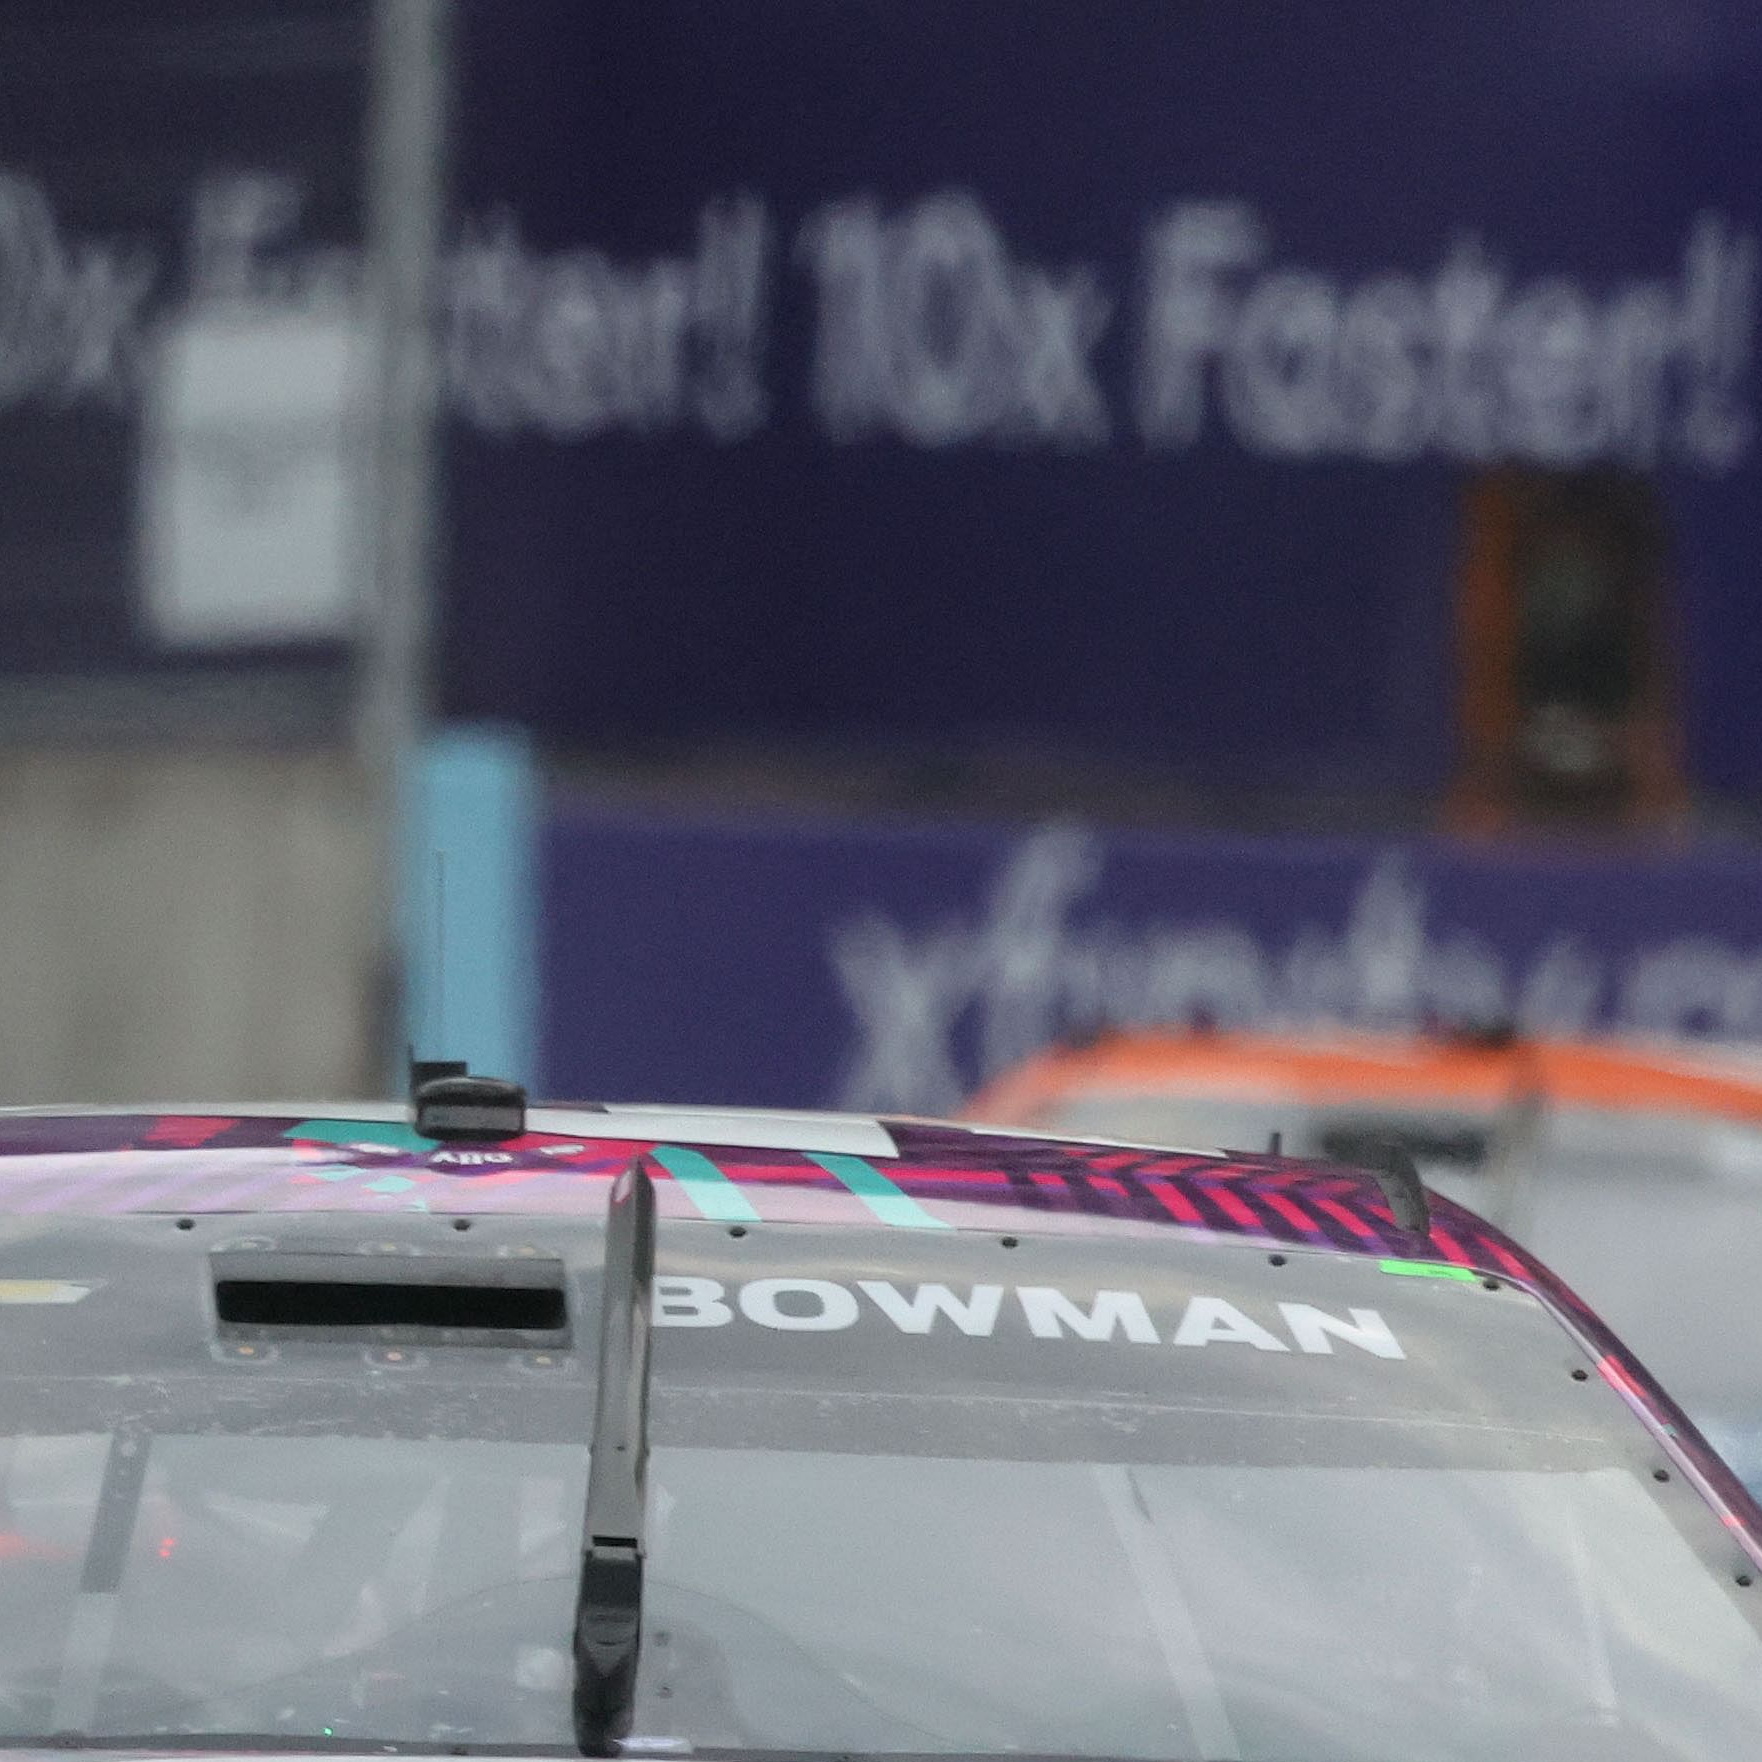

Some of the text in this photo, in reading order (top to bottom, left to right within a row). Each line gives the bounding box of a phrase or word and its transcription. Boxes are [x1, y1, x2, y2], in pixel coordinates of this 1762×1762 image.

[797, 186, 1109, 450] 10x
[1144, 202, 1754, 466] Faster!
[649, 1274, 1408, 1360] BOWMAN
